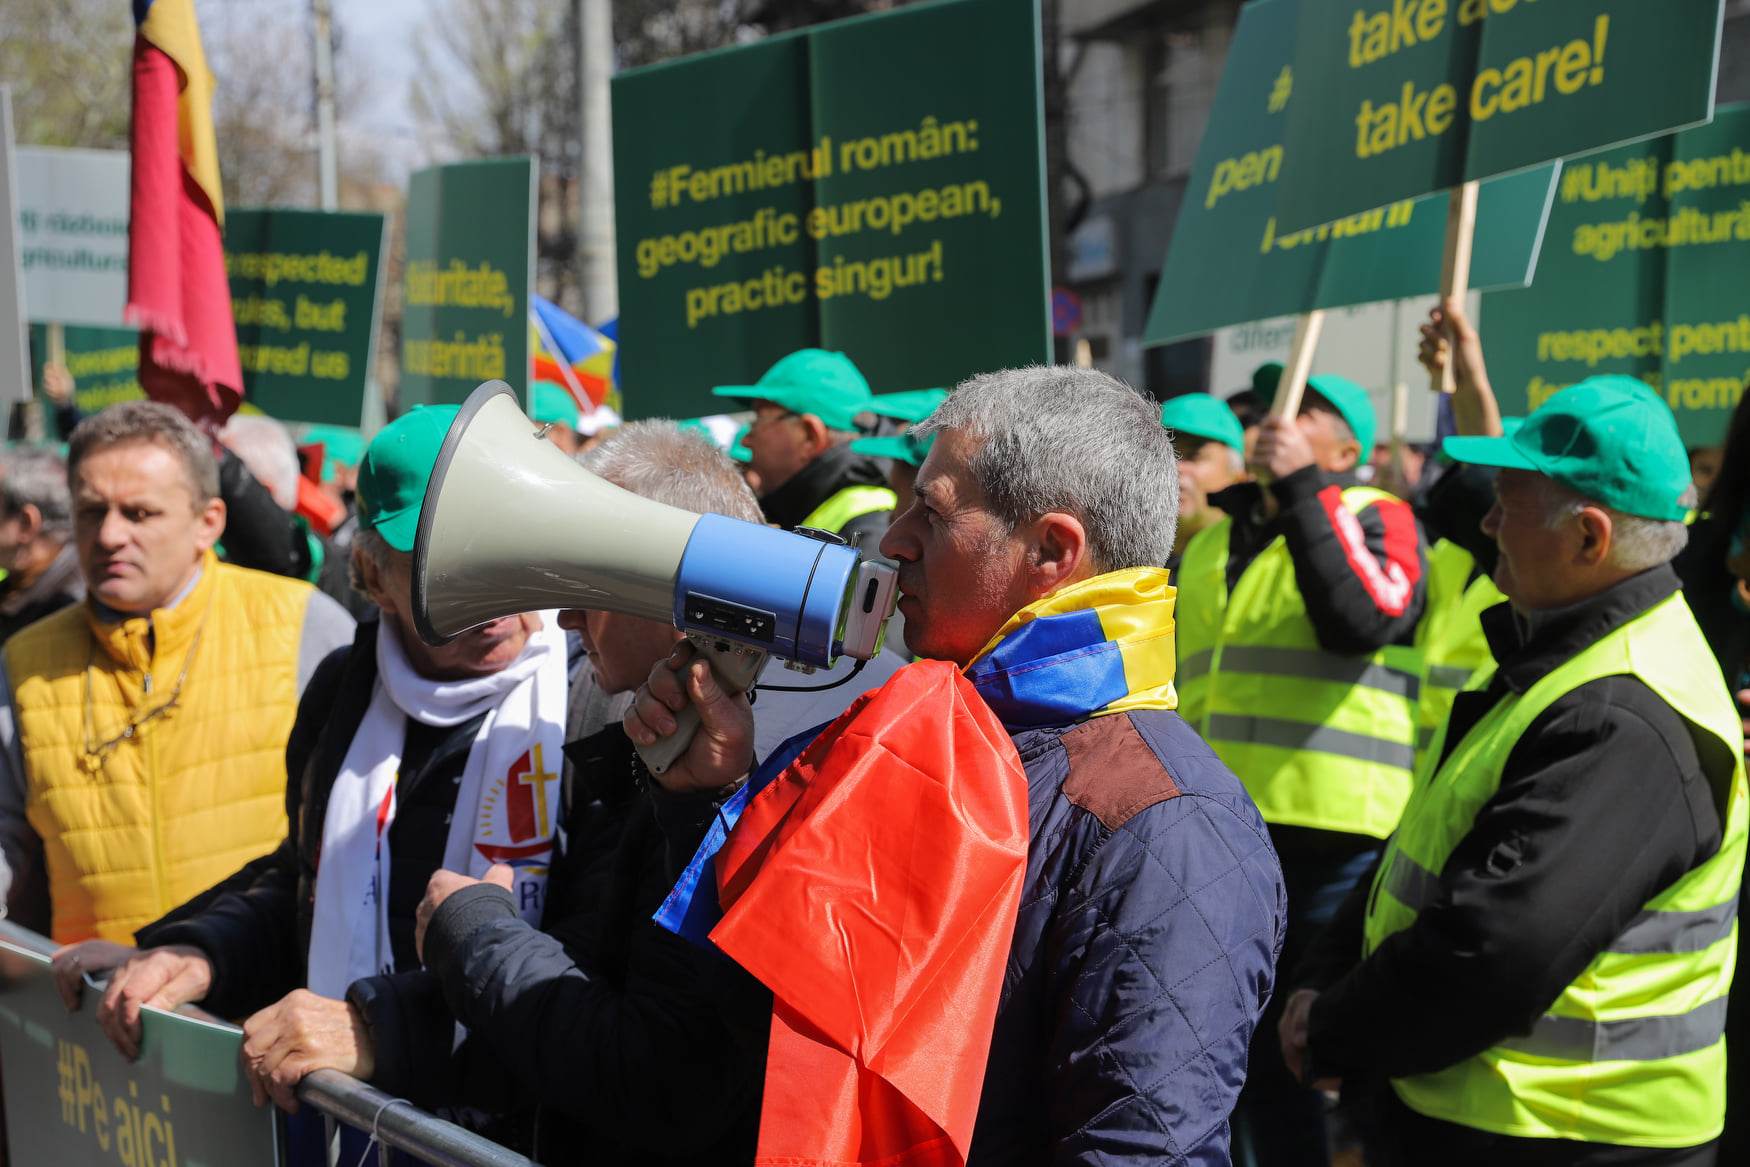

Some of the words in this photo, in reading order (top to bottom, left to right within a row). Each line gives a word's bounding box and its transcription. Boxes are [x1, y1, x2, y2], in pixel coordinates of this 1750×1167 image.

[1349, 0, 1448, 68] take
[1355, 80, 1457, 158] take
[1469, 14, 1611, 122] care!
[650, 136, 833, 208] #Fermierul
[840, 116, 979, 172] român:
[636, 207, 798, 278] geografic
[806, 179, 1002, 240] european,
[295, 293, 346, 332] but
[686, 266, 806, 328] practic
[815, 240, 944, 300] singur!
[311, 350, 350, 379] us
[1537, 320, 1664, 367] respect
[57, 1038, 111, 1153] #Pe
[114, 1079, 178, 1167] aici
